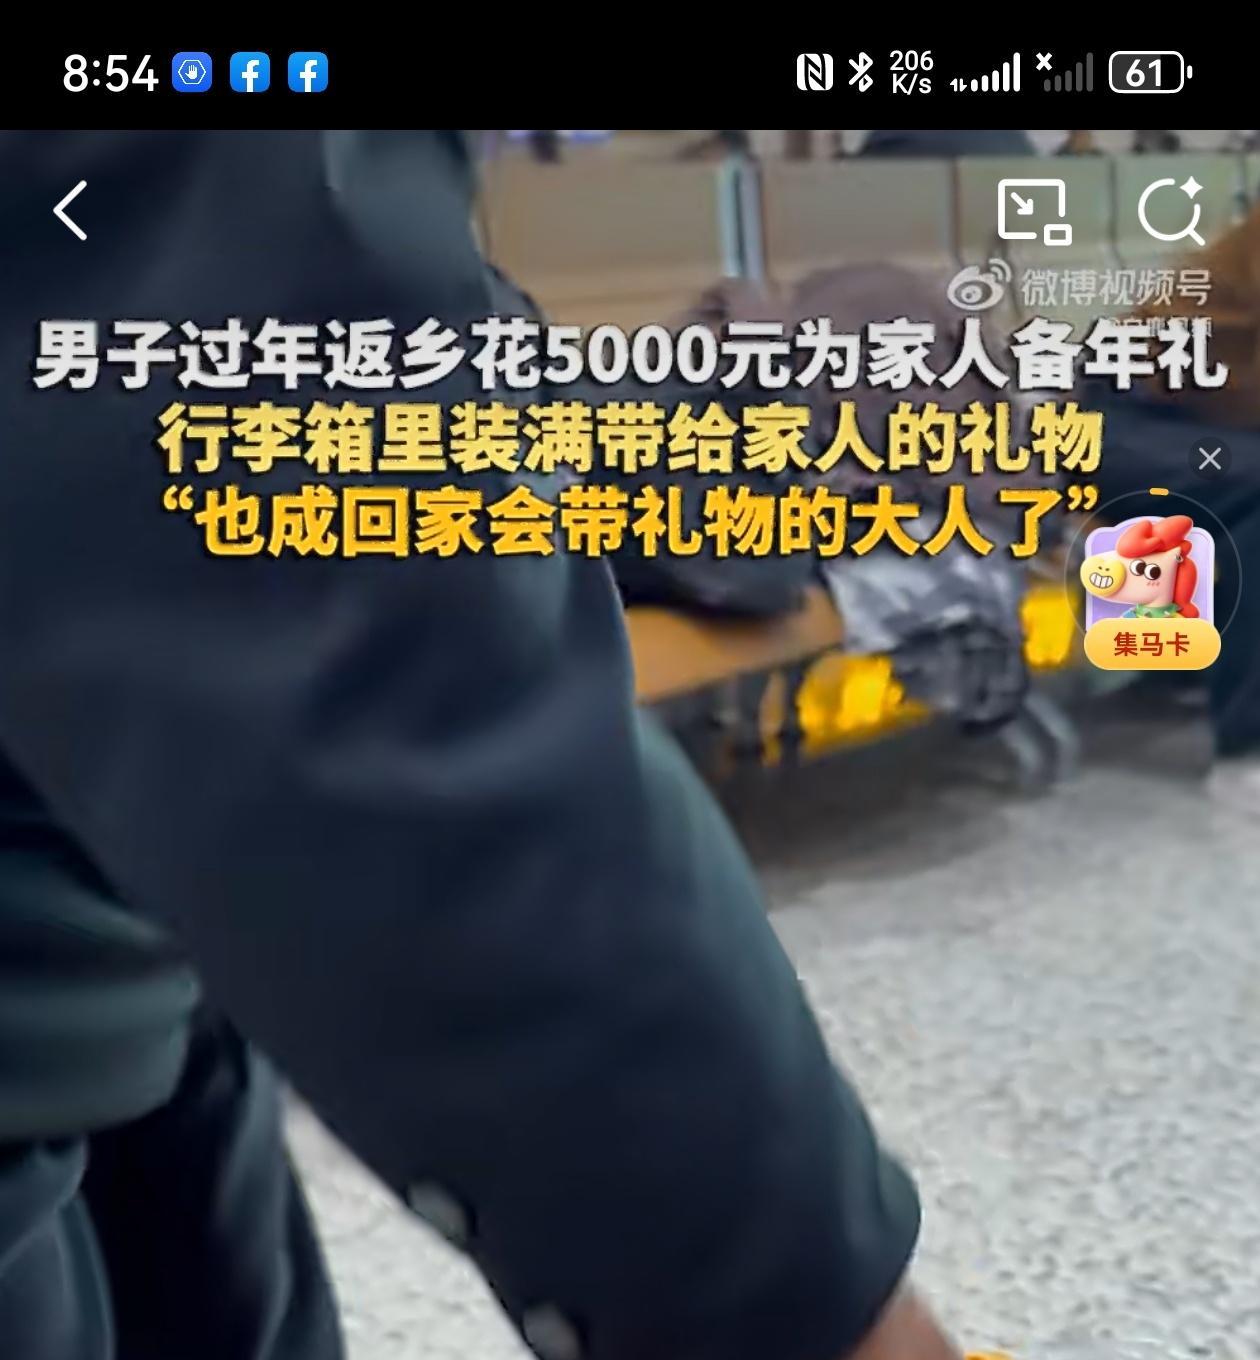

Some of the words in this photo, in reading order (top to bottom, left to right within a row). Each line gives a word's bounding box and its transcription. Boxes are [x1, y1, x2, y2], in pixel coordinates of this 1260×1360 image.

[63, 54, 159, 92] 8:54
[889, 50, 934, 71] 206
[1125, 59, 1162, 87] 61
[892, 74, 932, 95] K/s
[1113, 631, 1190, 657] 集马卡
